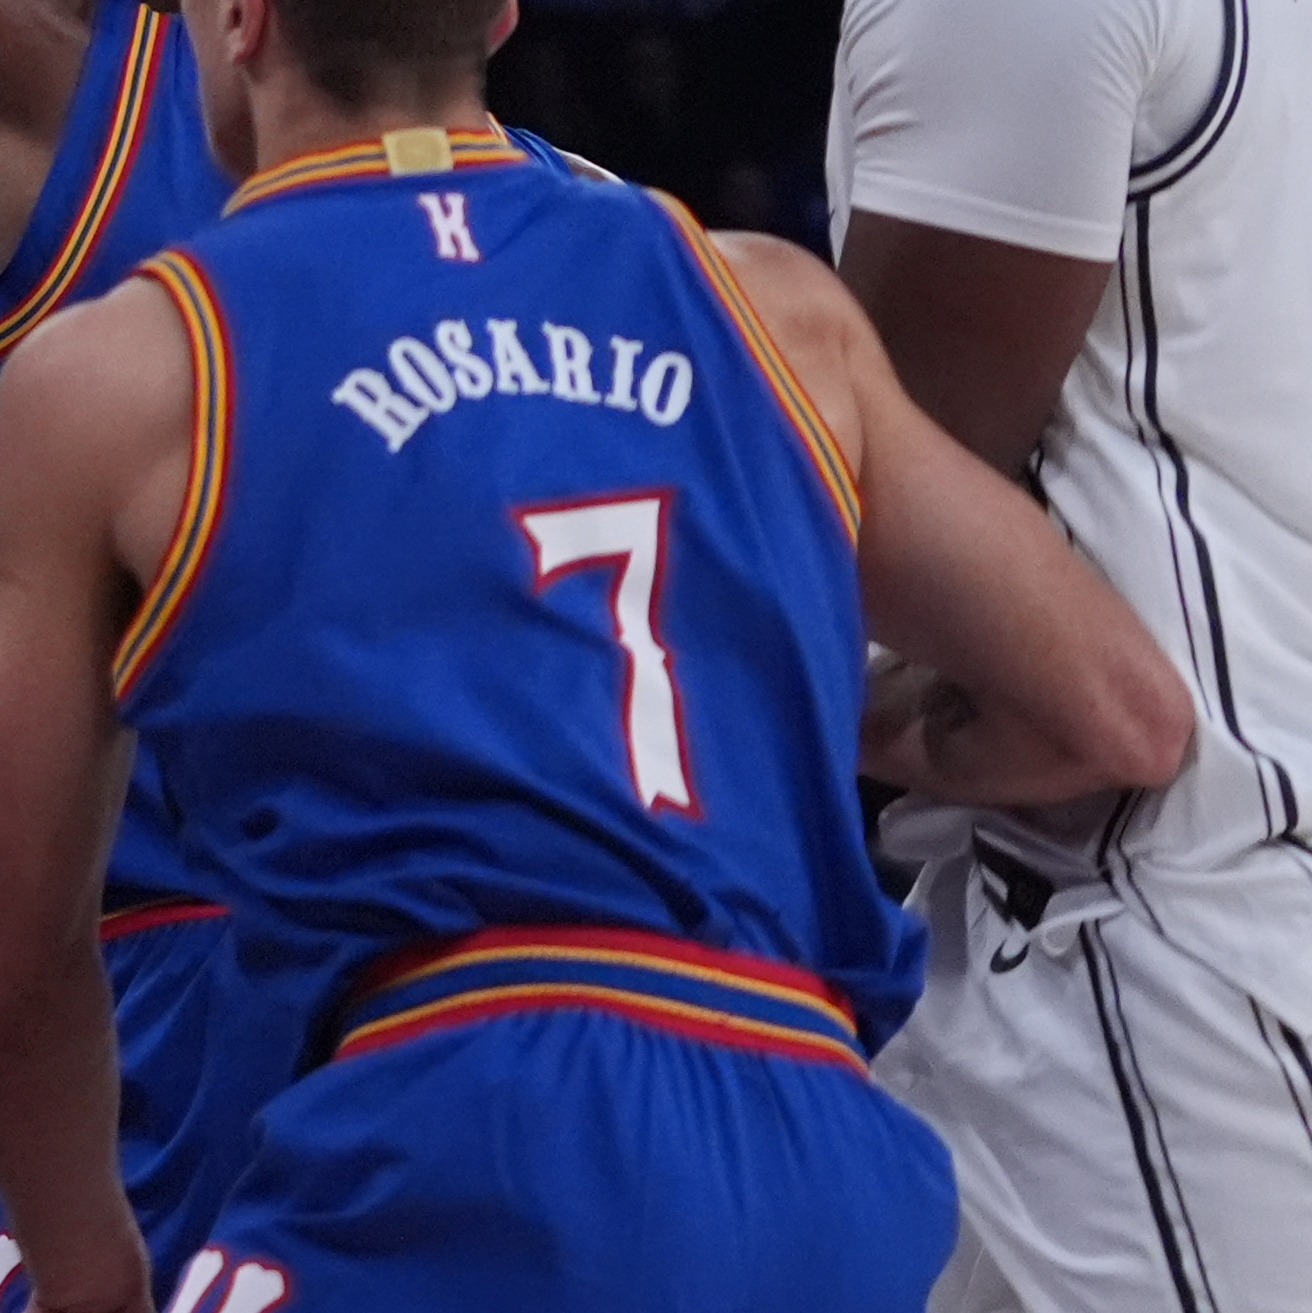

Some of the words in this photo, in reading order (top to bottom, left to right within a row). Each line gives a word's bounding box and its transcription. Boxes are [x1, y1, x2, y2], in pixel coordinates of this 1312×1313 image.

[417, 191, 481, 262] K
[330, 317, 694, 454] ROSARIO
[510, 487, 704, 820] 7
